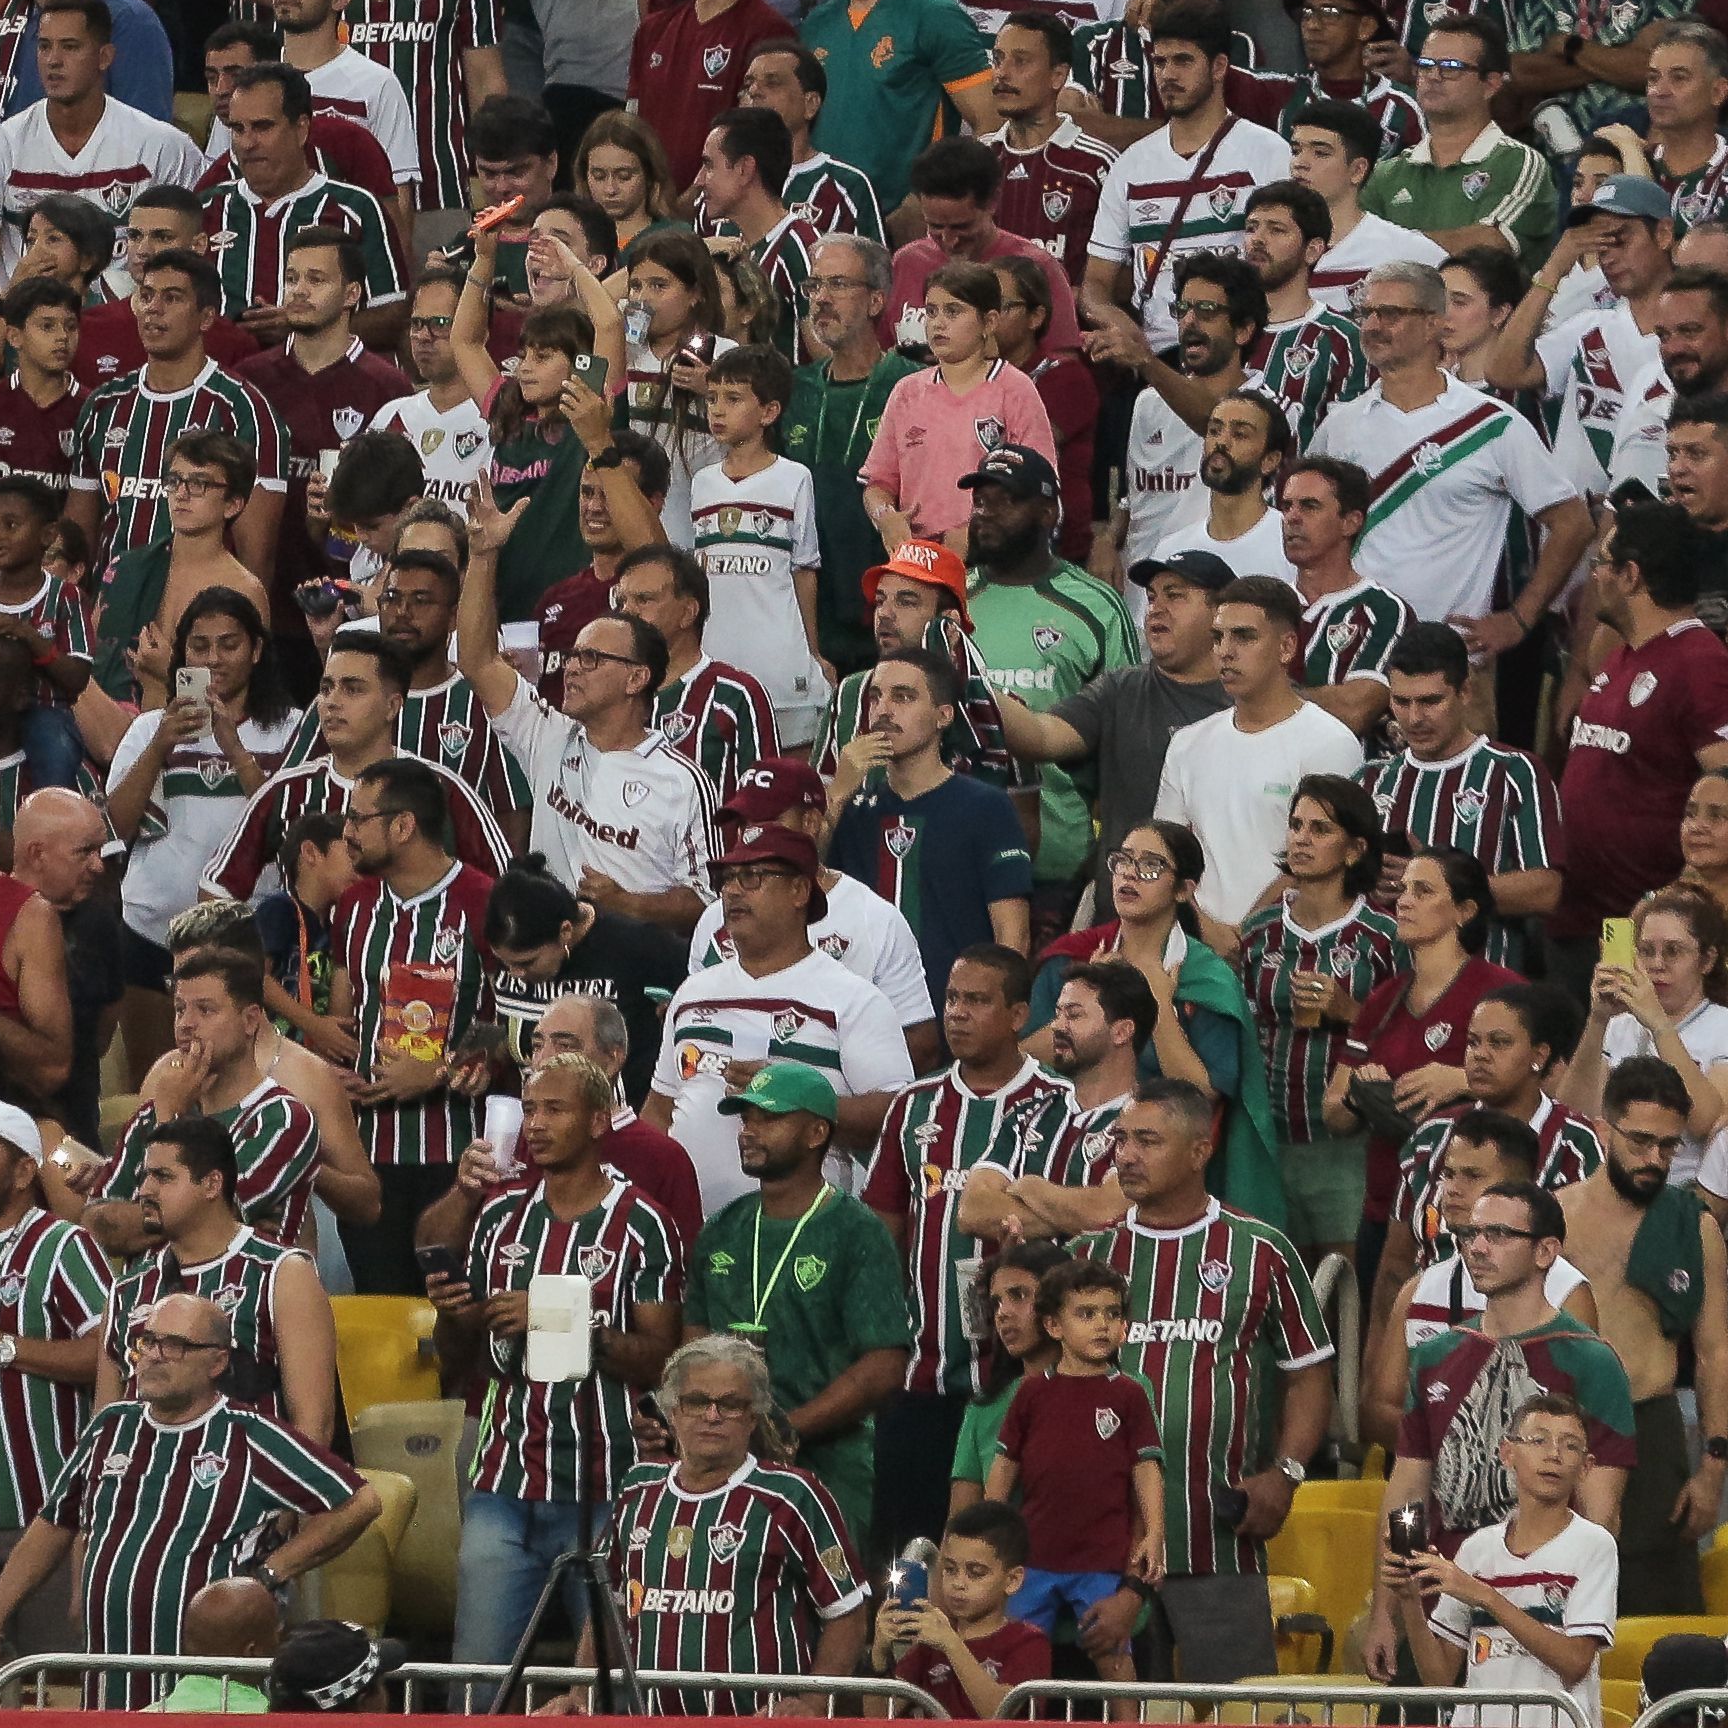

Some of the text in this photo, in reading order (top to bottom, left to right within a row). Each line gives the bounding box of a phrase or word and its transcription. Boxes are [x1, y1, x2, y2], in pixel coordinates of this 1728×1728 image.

[351, 22, 435, 44] BETANO
[120, 476, 169, 499] BETA
[422, 478, 472, 503] TANO
[739, 769, 774, 789] FC
[546, 780, 641, 851] Unimed
[494, 969, 528, 994] UIS
[1127, 1318, 1223, 1344] BETANO
[641, 1589, 734, 1614] BETANO
